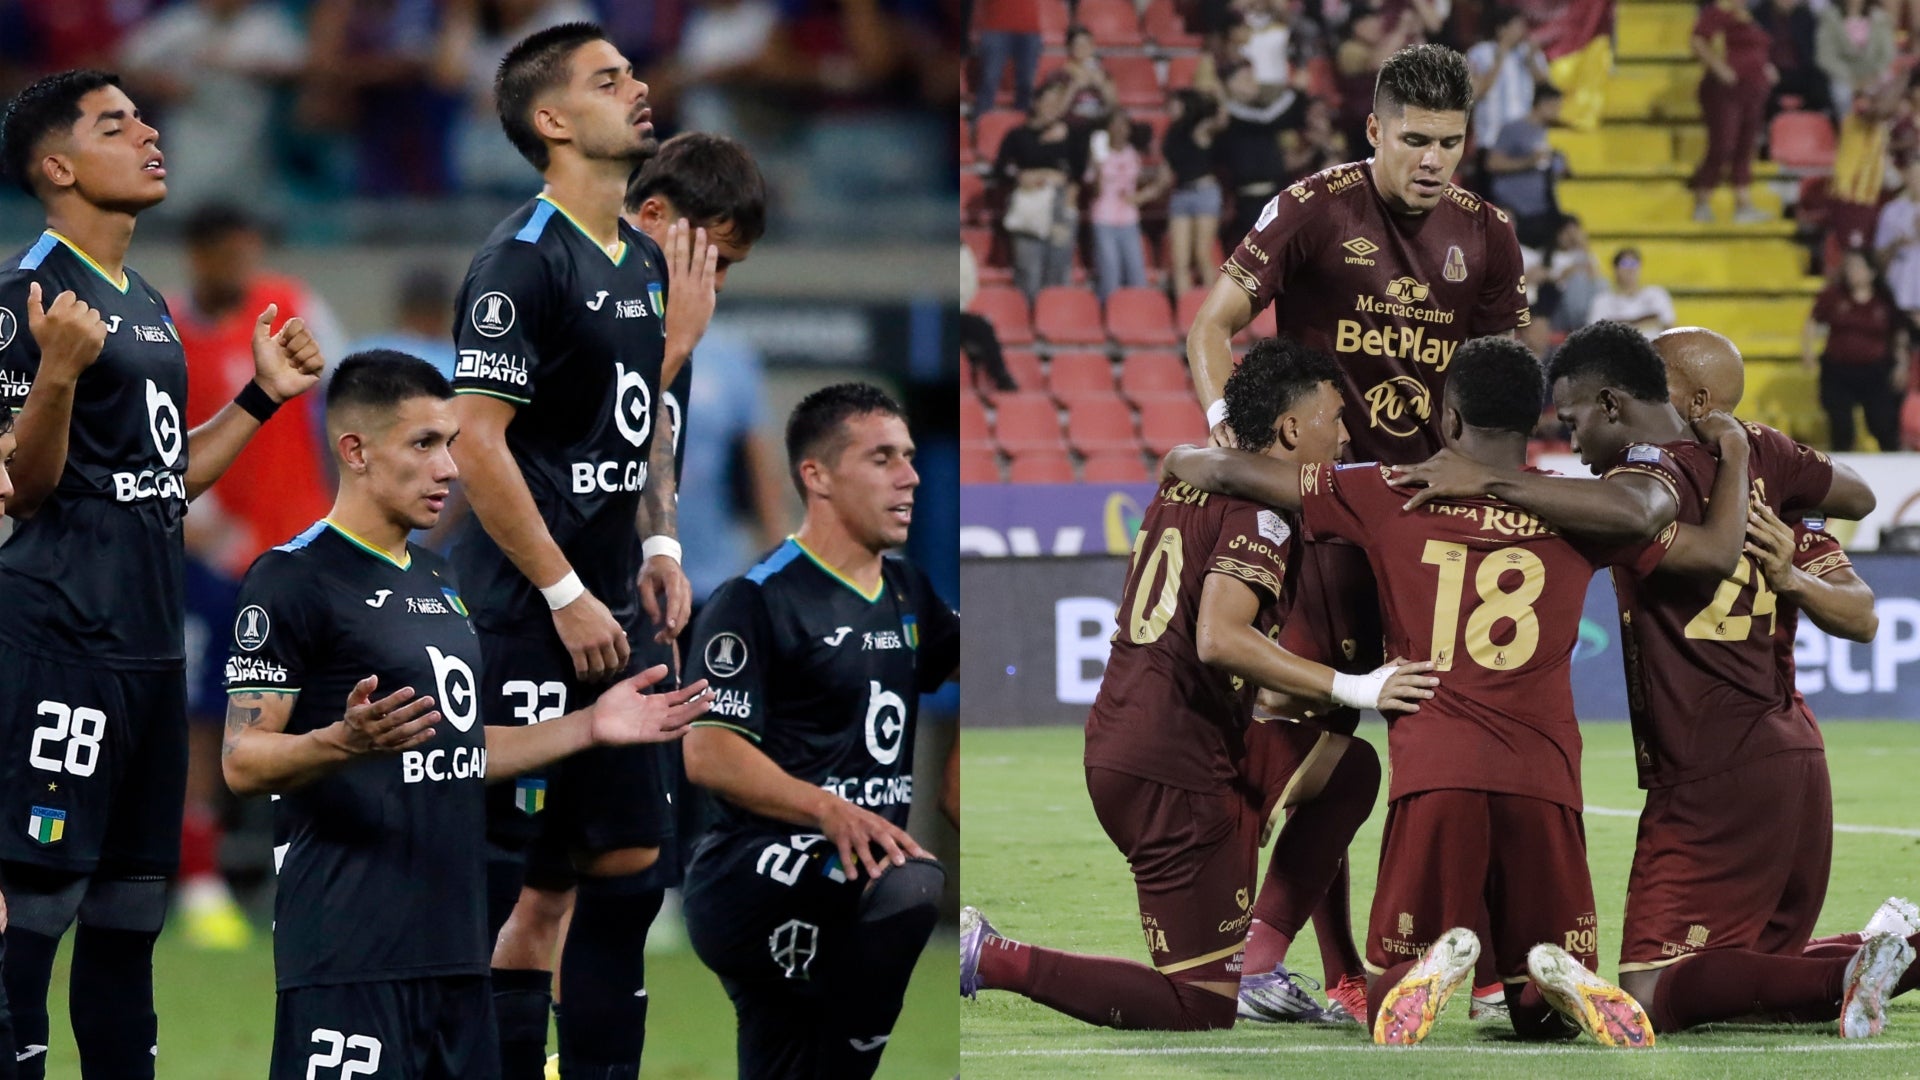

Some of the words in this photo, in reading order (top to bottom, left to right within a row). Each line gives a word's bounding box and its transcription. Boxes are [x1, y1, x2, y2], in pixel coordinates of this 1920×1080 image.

[1327, 168, 1363, 193] Multi
[1345, 256, 1376, 266] umbro
[1355, 294, 1454, 324] Mercacentro
[1335, 319, 1459, 373] BetPlay
[481, 350, 529, 374] MALL
[0, 369, 32, 385] ALL
[479, 364, 529, 386] PATIO
[1480, 505, 1558, 537] ROJ
[1421, 538, 1546, 672] 18
[239, 656, 288, 672] MALL
[242, 667, 287, 683] PATIO
[29, 699, 107, 778] 28
[1393, 944, 1426, 955] TOLIM
[1564, 926, 1598, 954] ROJ
[305, 1027, 382, 1080] 22
